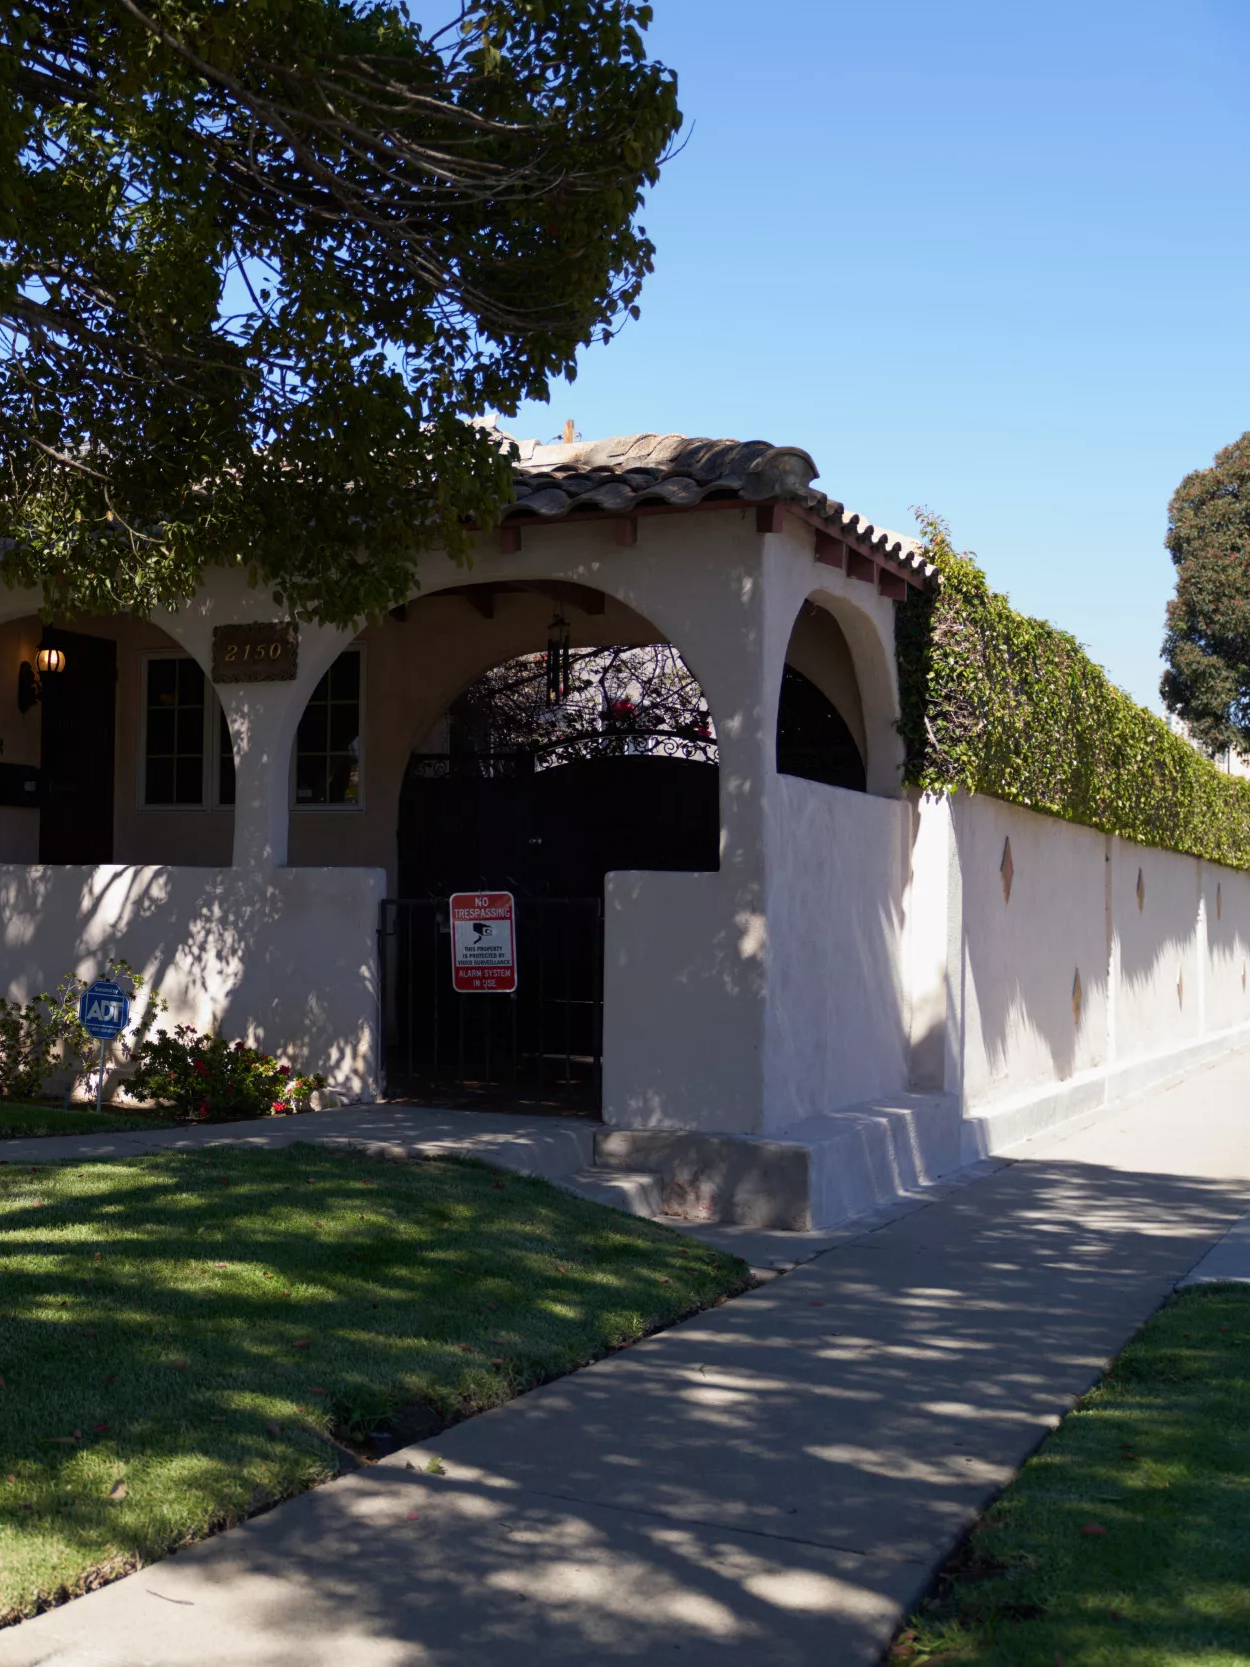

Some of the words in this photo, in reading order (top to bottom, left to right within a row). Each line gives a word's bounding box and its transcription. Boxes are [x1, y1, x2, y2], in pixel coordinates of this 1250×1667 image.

[225, 642, 282, 662] 2150
[474, 897, 488, 906] NO
[454, 907, 511, 919] TRESPASSING
[484, 969, 510, 977] SYSTEM
[473, 979, 481, 987] IN
[483, 979, 497, 988] USE
[86, 1000, 124, 1023] ADT
